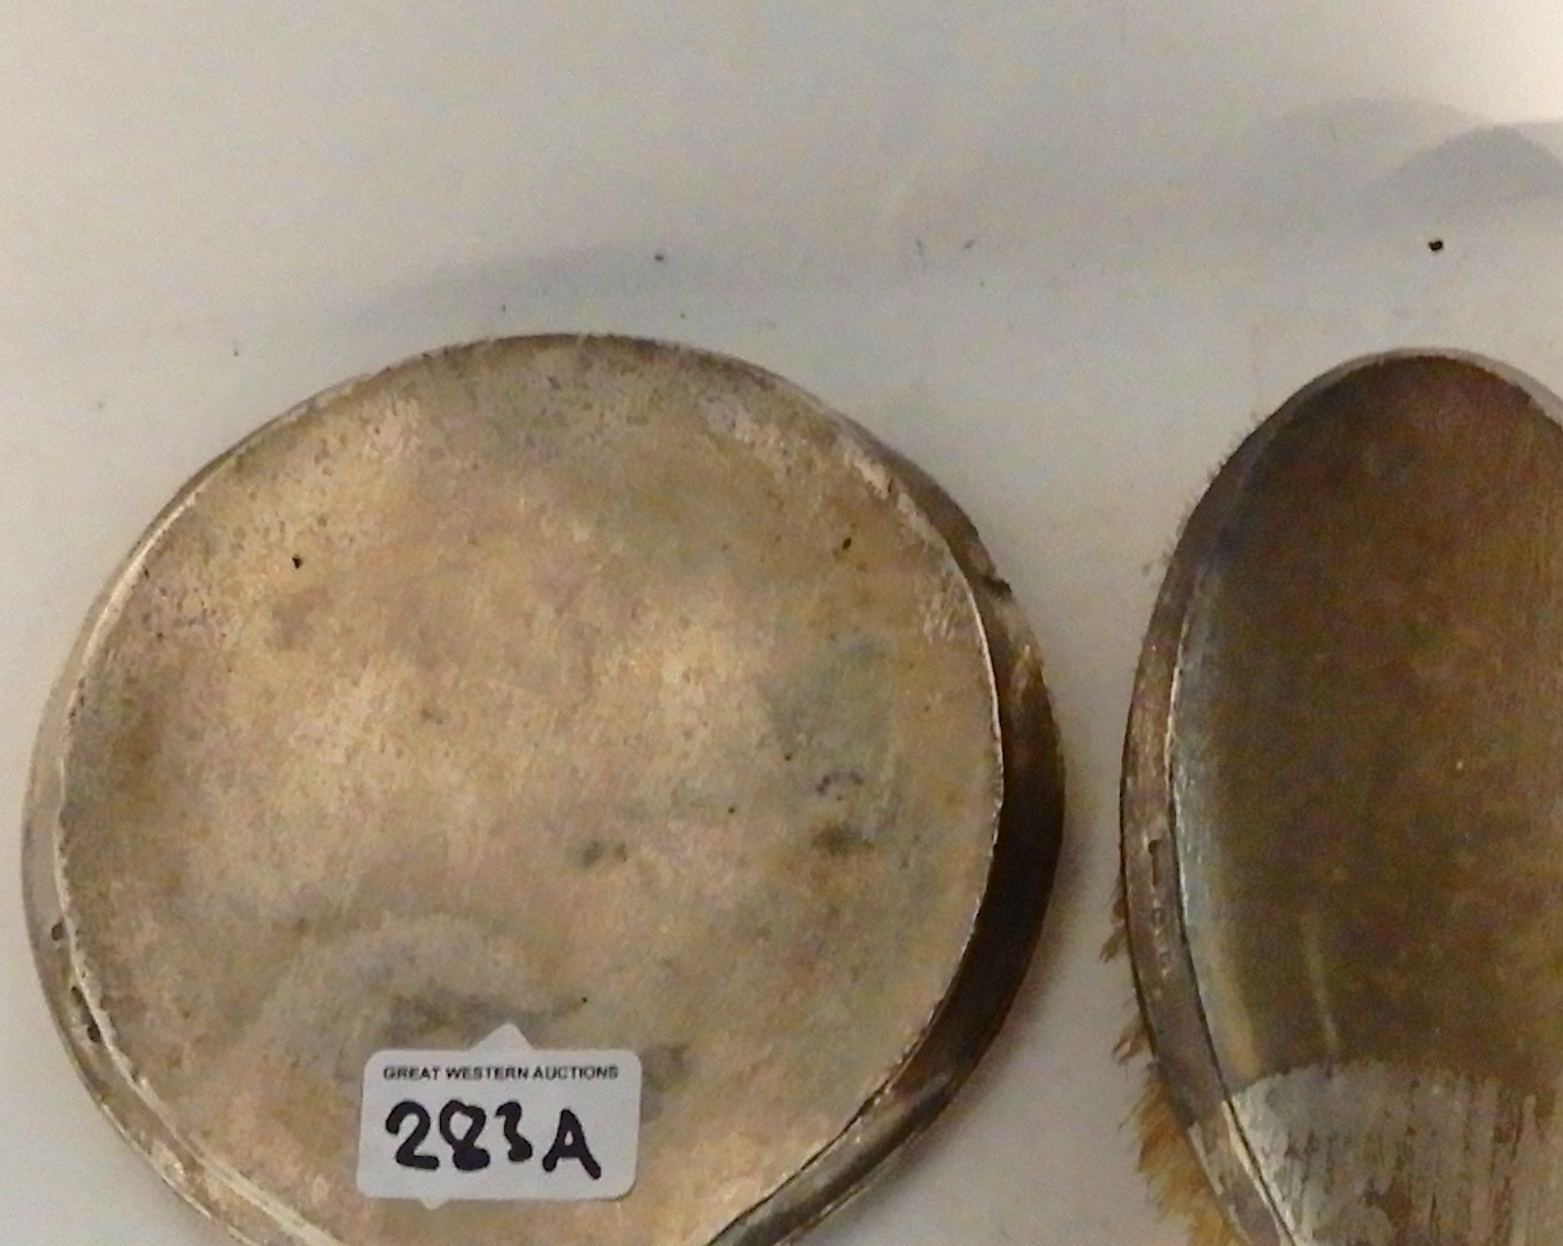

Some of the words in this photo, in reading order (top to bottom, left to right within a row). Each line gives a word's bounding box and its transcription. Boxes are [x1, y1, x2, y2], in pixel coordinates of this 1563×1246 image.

[383, 1066, 439, 1080] GREAT
[446, 1066, 529, 1080] WESTERN
[533, 1065, 619, 1080] AUCTIONS
[385, 1099, 602, 1180] 283A
